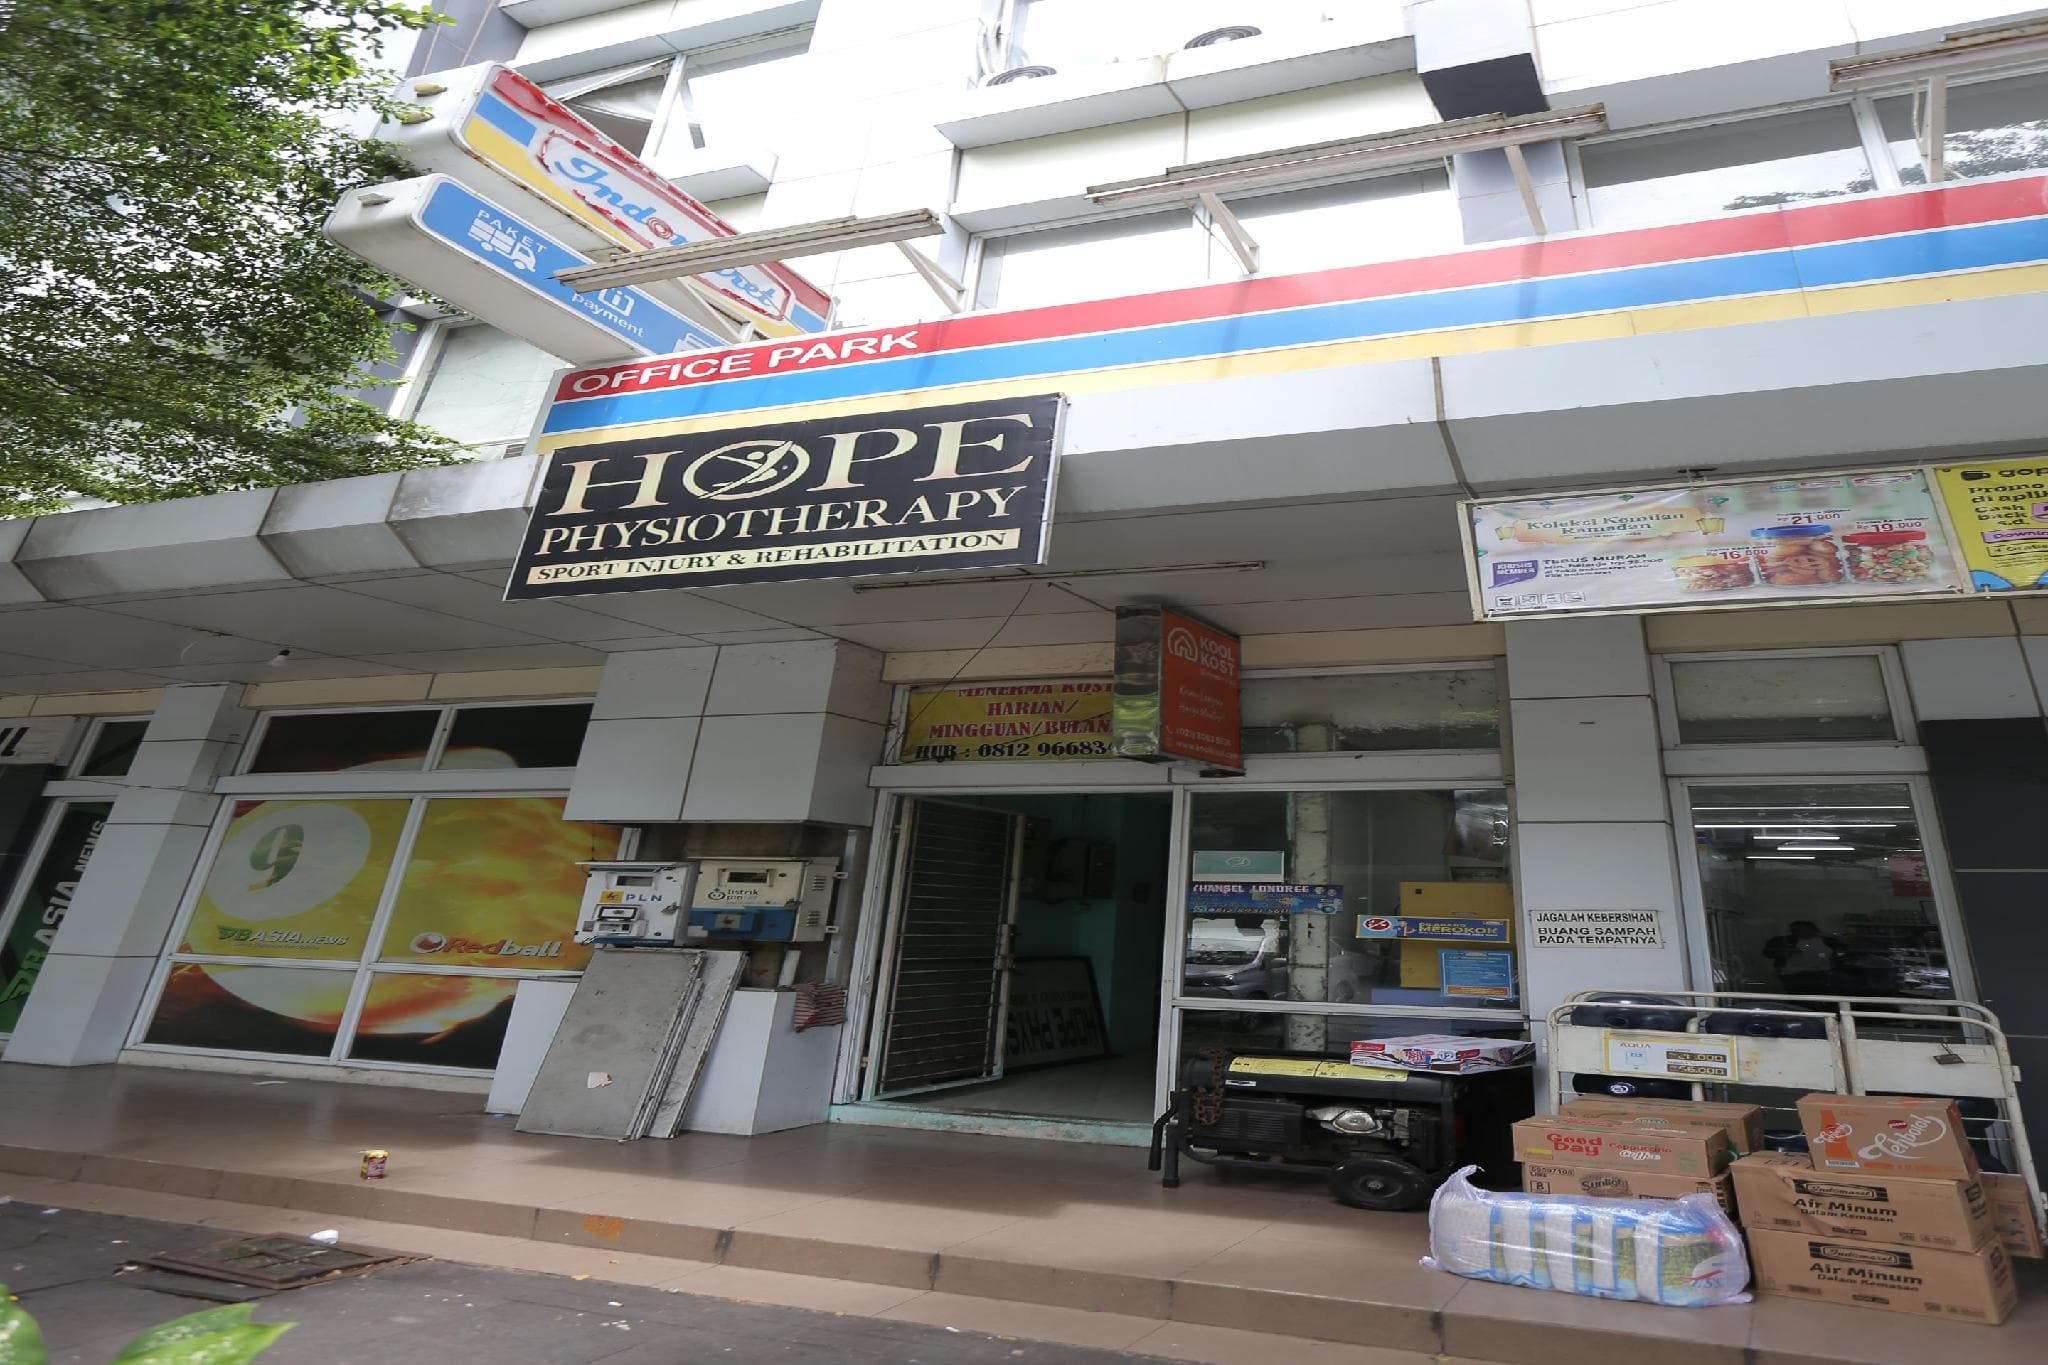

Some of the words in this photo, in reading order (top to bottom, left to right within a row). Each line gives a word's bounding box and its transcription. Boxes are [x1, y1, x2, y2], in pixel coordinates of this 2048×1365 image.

[477, 209, 548, 253] PAKET
[571, 292, 646, 338] payment
[572, 353, 754, 393] OFFICE
[768, 330, 918, 368] PARK
[545, 413, 1035, 517] HOPE
[1968, 483, 2044, 493] Promo
[1975, 504, 2025, 513] Cash
[1978, 512, 2028, 520] back
[534, 486, 1029, 556] PHYSIOTHERAPY
[537, 562, 622, 581] SPORT
[624, 553, 722, 577] INJURY
[727, 552, 746, 566] &
[756, 532, 1007, 564] REHABILITATION
[1200, 636, 1235, 662] KOOL
[1200, 653, 1235, 676] KOST
[929, 719, 1113, 738] MINGGUAN/BULAN
[915, 744, 956, 760] HUB
[978, 743, 1029, 757] 0812
[625, 893, 663, 902] PLN
[1537, 913, 1585, 922] JAGALAH
[1587, 913, 1653, 923] KEBERSIHAN
[1418, 926, 1498, 934] MEROKOK
[1538, 927, 1590, 935] BUANG
[1594, 927, 1656, 936] SAMPAH
[1539, 936, 1575, 944] PADA
[1577, 936, 1658, 945] TEMPATNYA
[1546, 1133, 1603, 1147] Good
[1553, 1143, 1601, 1157] Day
[1581, 1177, 1629, 1192] Sunlight
[1792, 1198, 1825, 1209] Air
[1828, 1202, 1898, 1217] Minum
[1840, 1212, 1895, 1223] Kemasan
[1825, 1247, 1895, 1264] Indomaret
[1809, 1262, 1841, 1275] Air
[1846, 1266, 1923, 1285] Minum
[1817, 1273, 1857, 1286] Dalam
[1860, 1277, 1920, 1292] Kemasan
